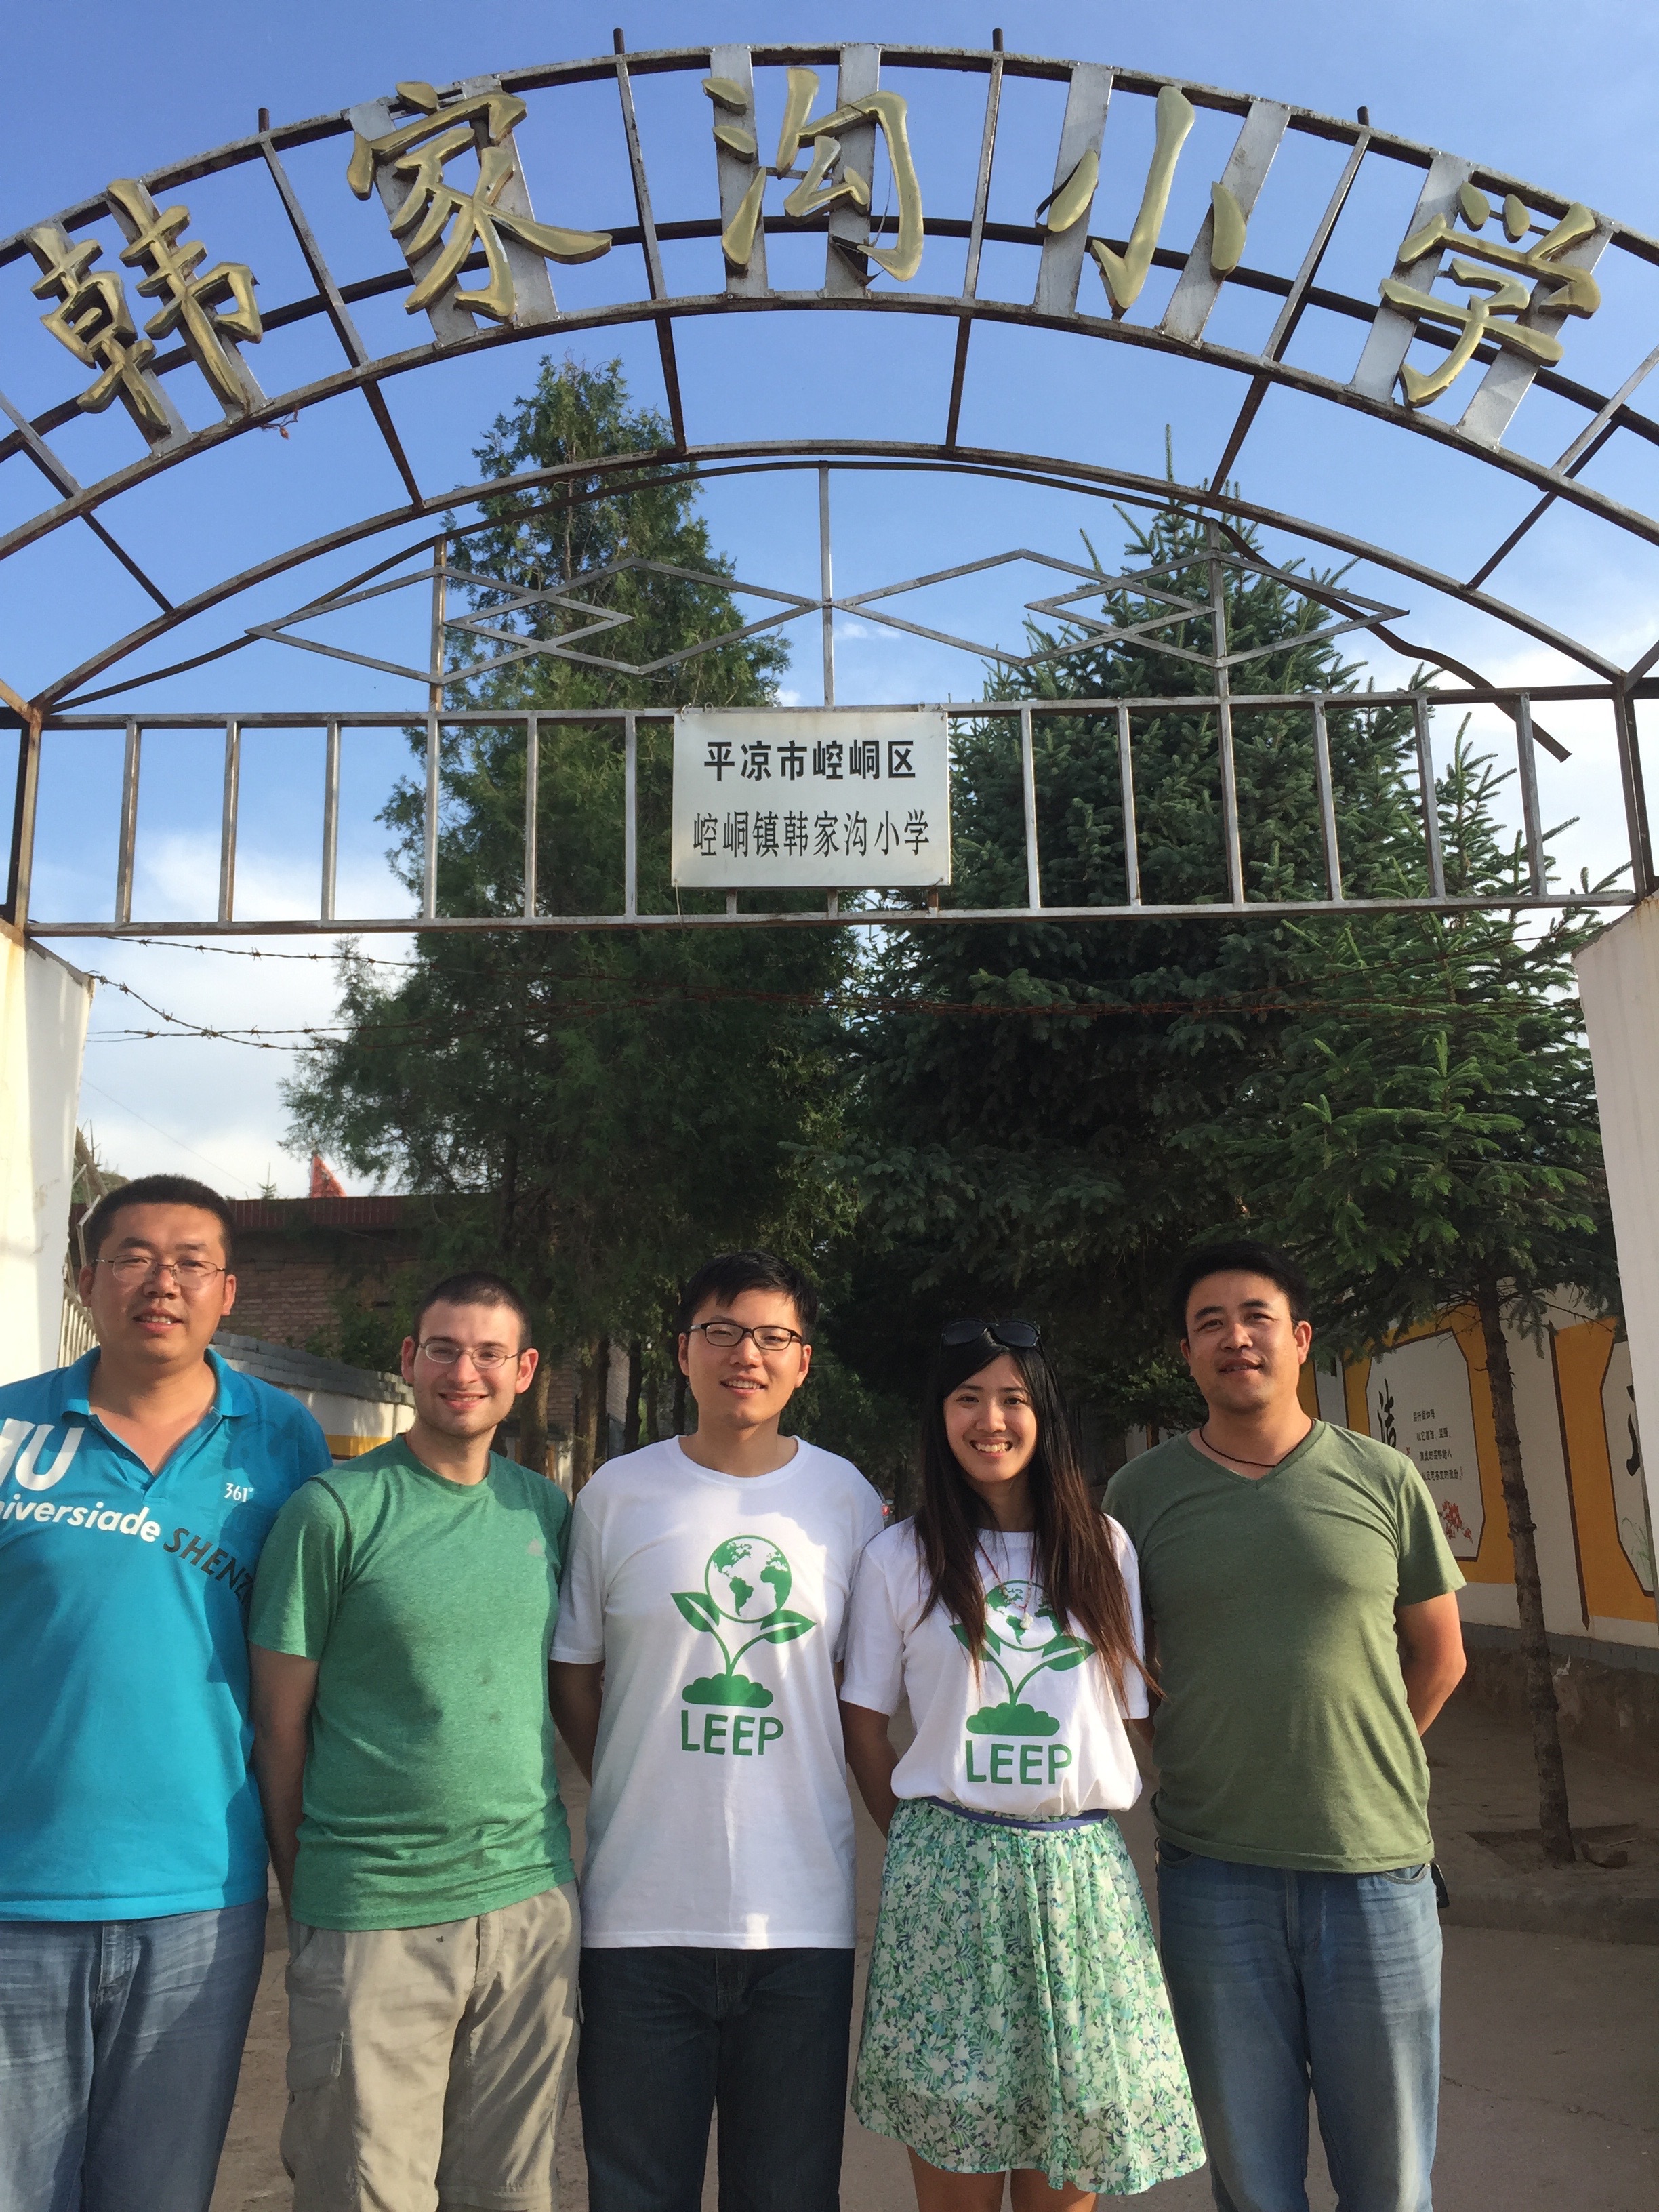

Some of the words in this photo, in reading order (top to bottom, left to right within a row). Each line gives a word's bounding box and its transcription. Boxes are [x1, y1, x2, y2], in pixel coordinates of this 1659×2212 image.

[30, 68, 1602, 434] 韩家沟小学
[704, 739, 916, 782] 平凉市崆峒区
[693, 809, 930, 858] 崆峒镇韩家沟小学
[162, 1528, 253, 1606] SHENZ
[681, 1709, 785, 1757] LEEP
[965, 1740, 1073, 1785] LEEP
